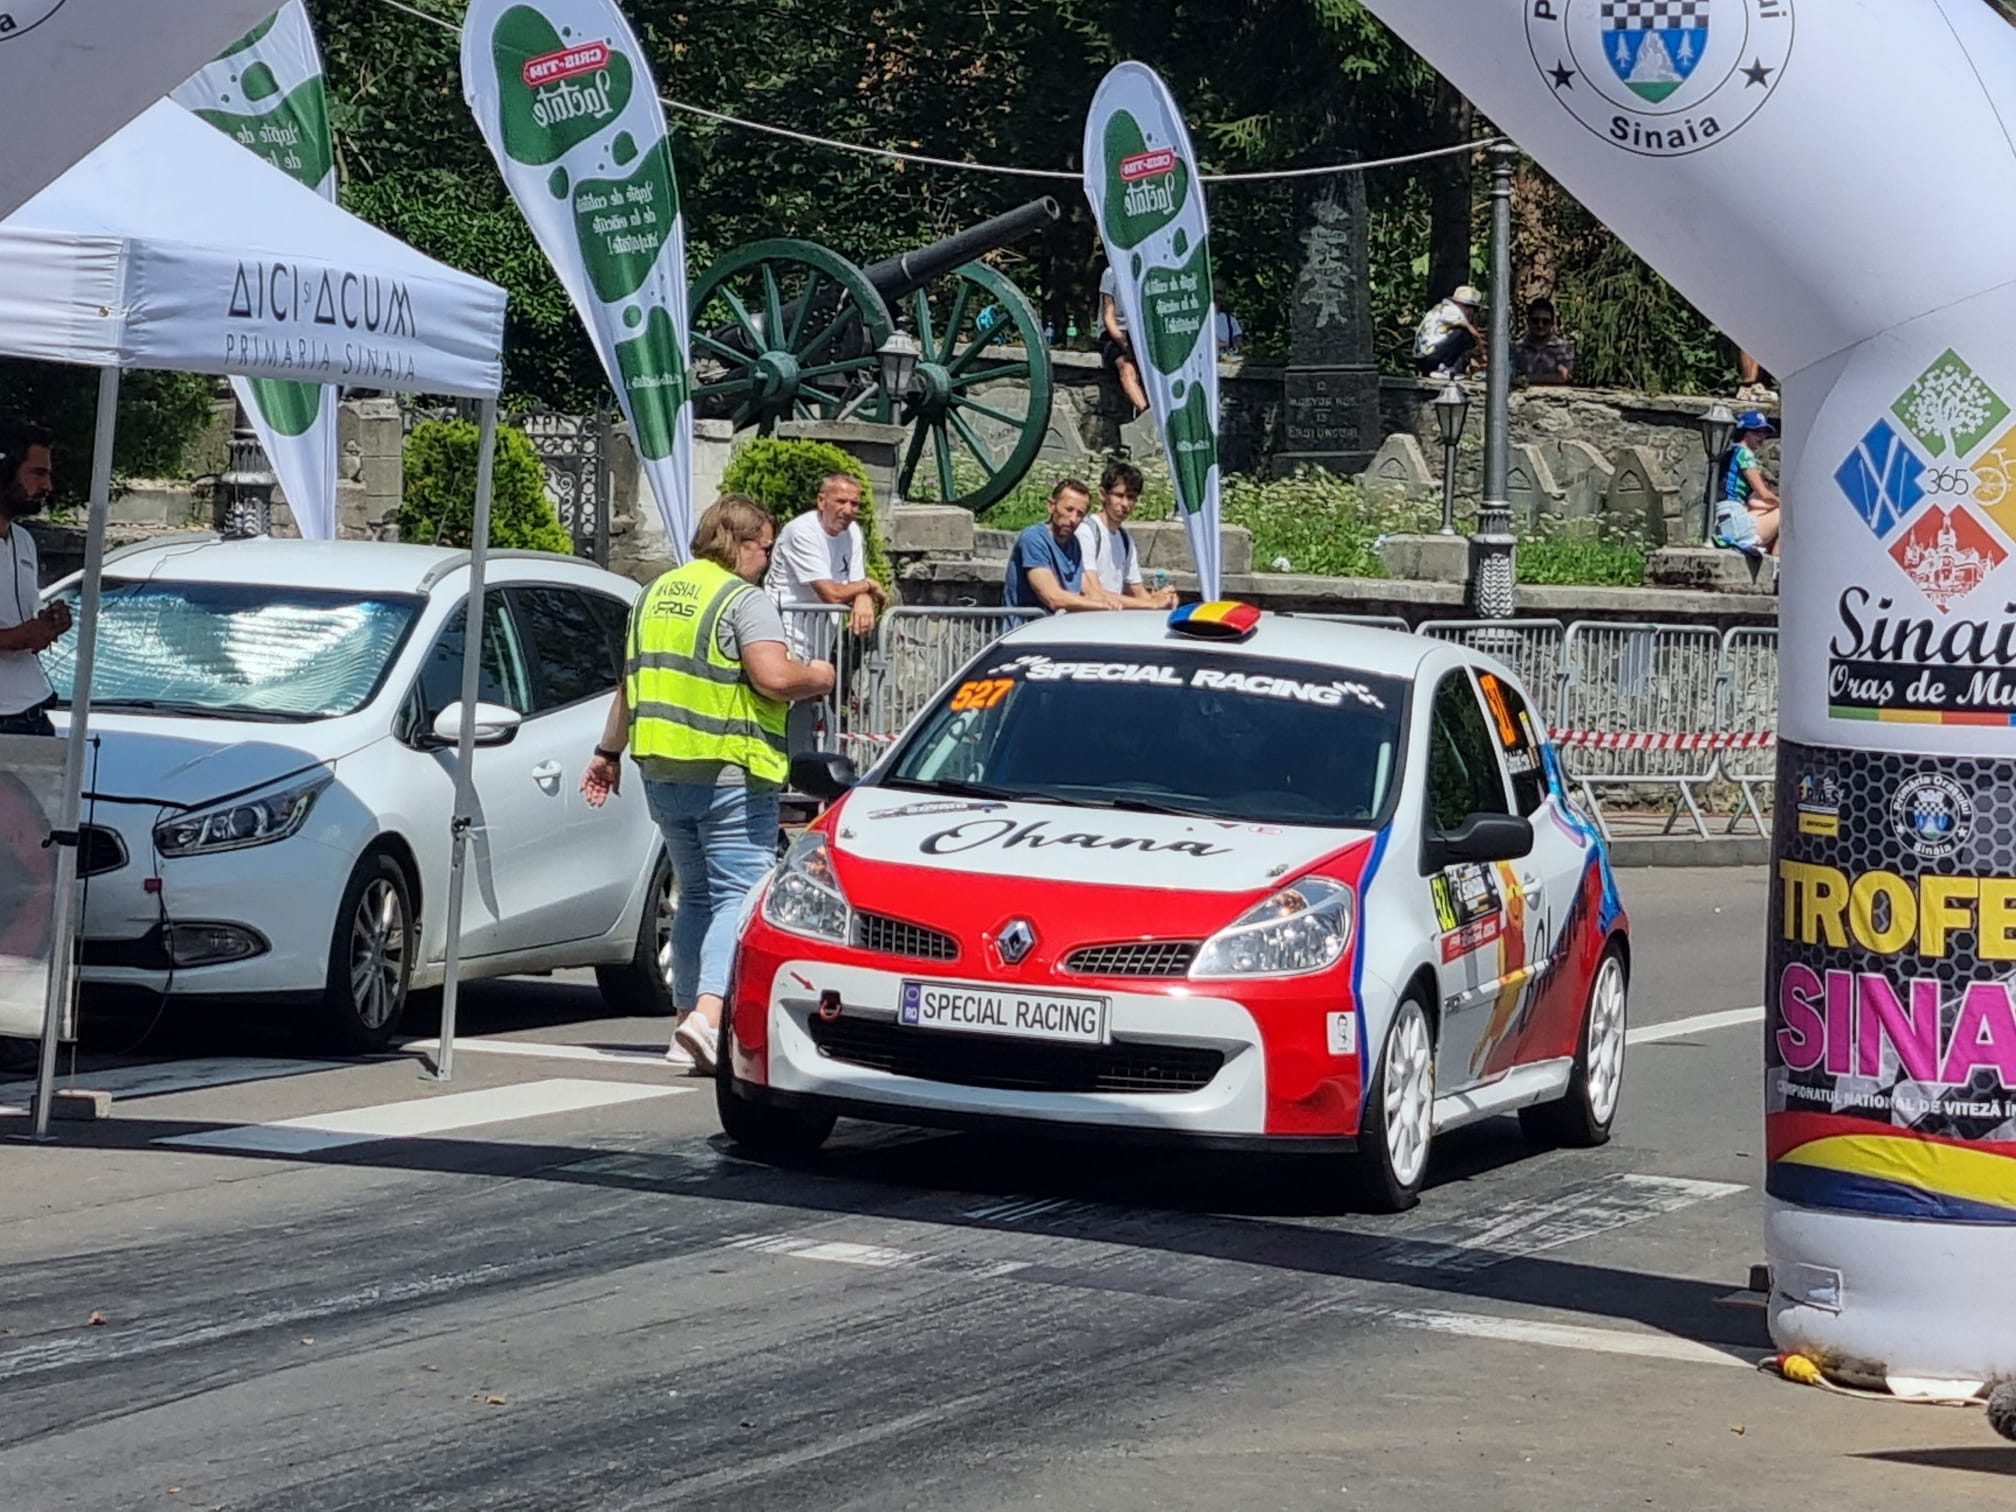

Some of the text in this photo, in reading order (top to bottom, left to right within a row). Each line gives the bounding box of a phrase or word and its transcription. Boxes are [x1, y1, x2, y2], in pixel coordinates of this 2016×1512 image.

[1609, 115, 1721, 150] Sinaia
[228, 260, 299, 323] AICI
[314, 268, 416, 339] ACUM
[224, 333, 416, 382] PRIMARIA SINAIA
[1926, 467, 1969, 496] 365
[951, 679, 1015, 711] 527
[1026, 663, 1343, 706] SPECIAL RACING
[1905, 669, 1947, 703] de
[919, 819, 1234, 857] Ohana
[1779, 859, 2016, 960] TROFE
[923, 992, 1096, 1034] SPECIAL RACING
[1776, 962, 2016, 1090] SINA
[1919, 1099, 1942, 1113] DE
[1945, 1099, 2001, 1117] VITEZĂ
